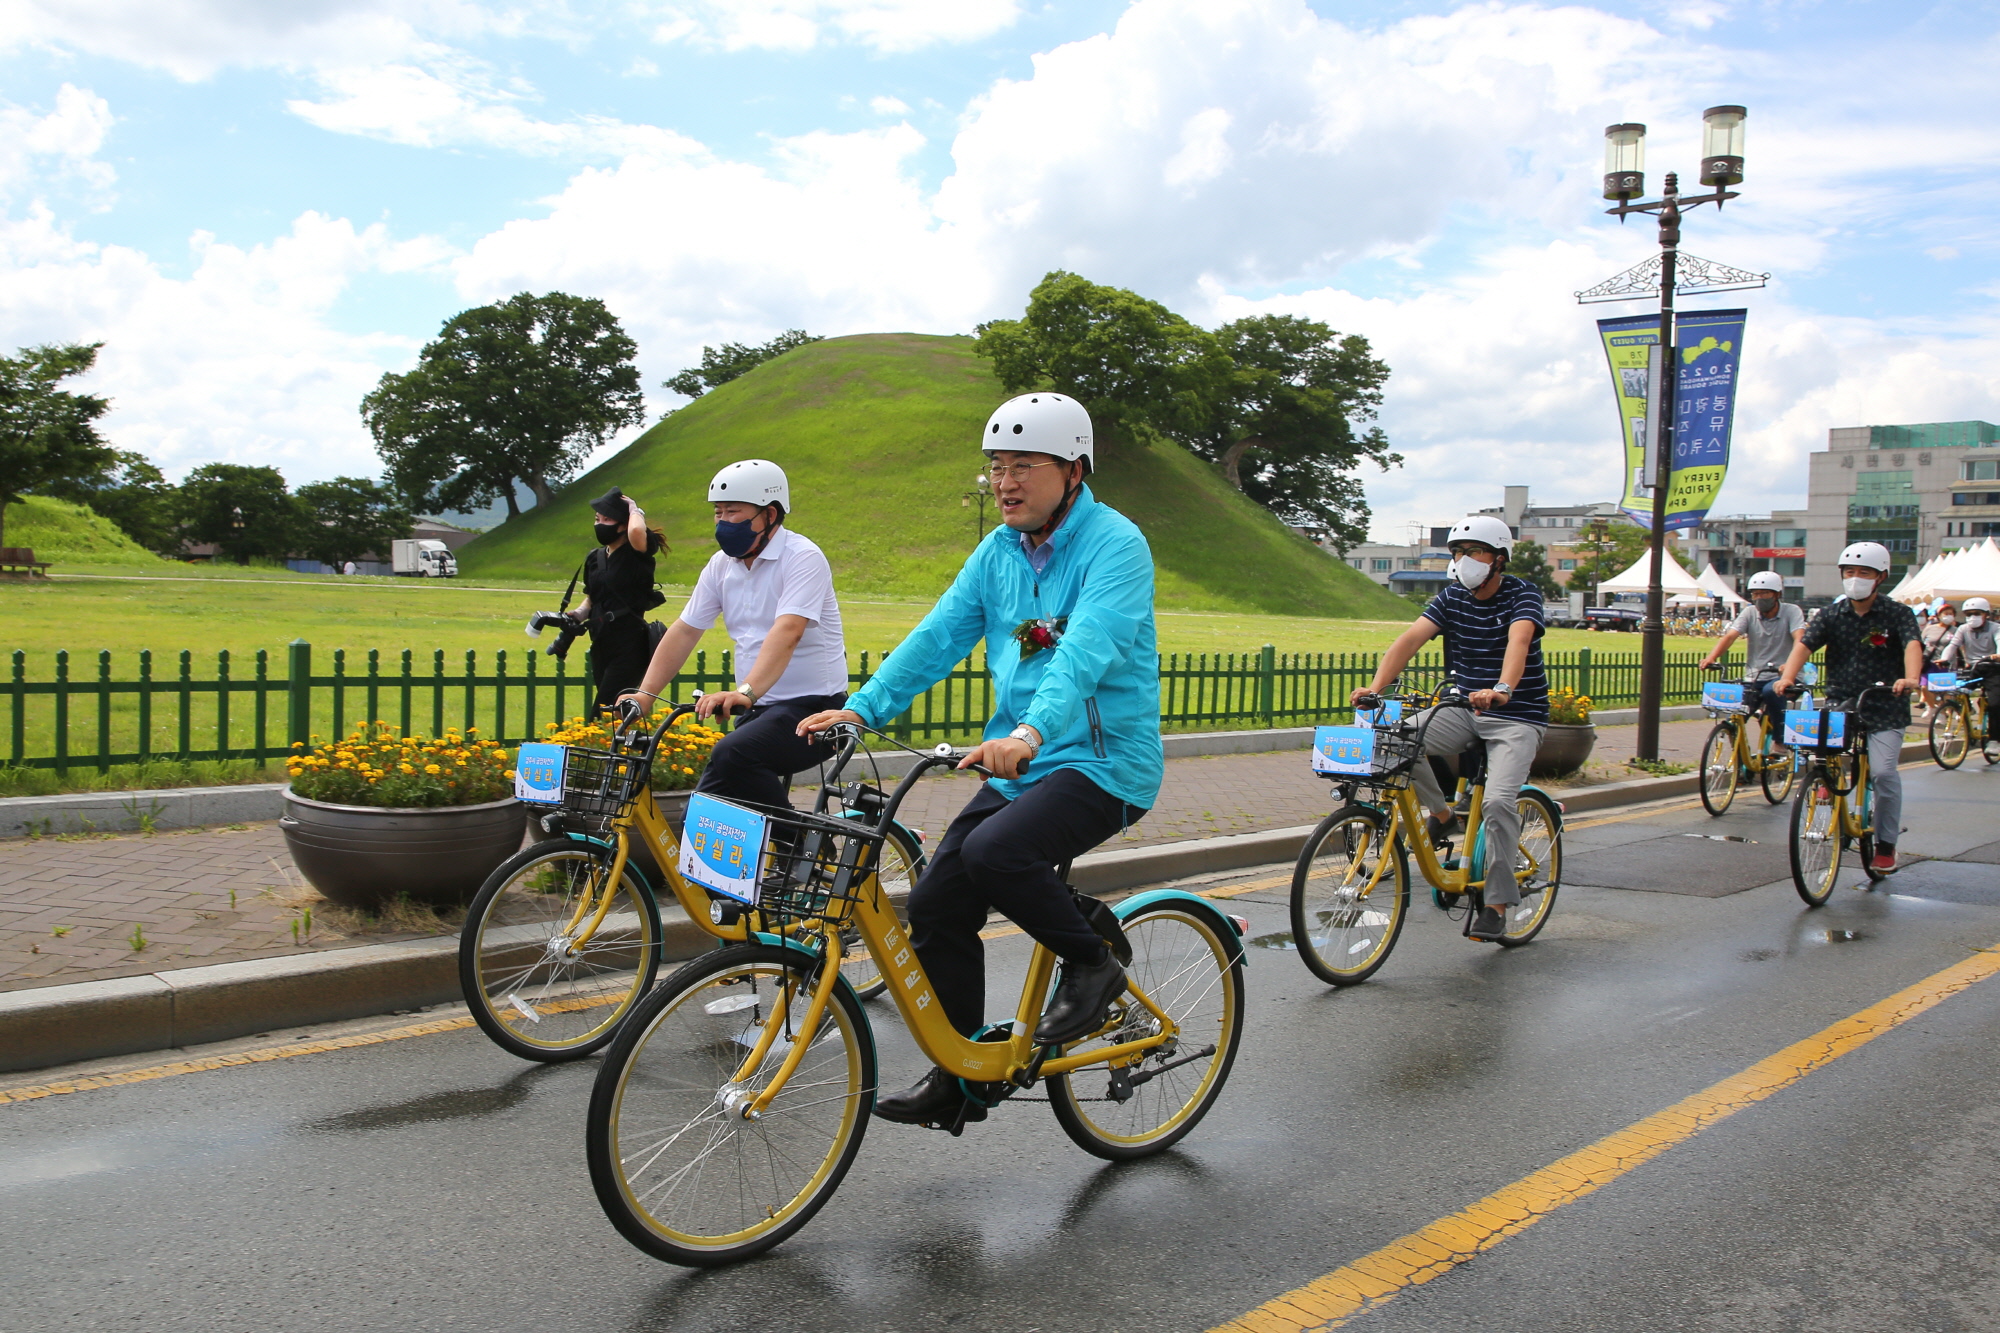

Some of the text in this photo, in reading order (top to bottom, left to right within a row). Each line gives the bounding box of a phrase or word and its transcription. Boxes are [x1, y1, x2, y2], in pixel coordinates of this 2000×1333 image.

[1323, 745, 1362, 758] 타실라
[523, 767, 554, 782] 타실라
[697, 816, 716, 832] 경주시
[716, 822, 748, 843] 공영자전거
[693, 832, 744, 868] 타실라
[894, 946, 932, 1011] 타실라
[962, 1058, 984, 1070] GJ0227
